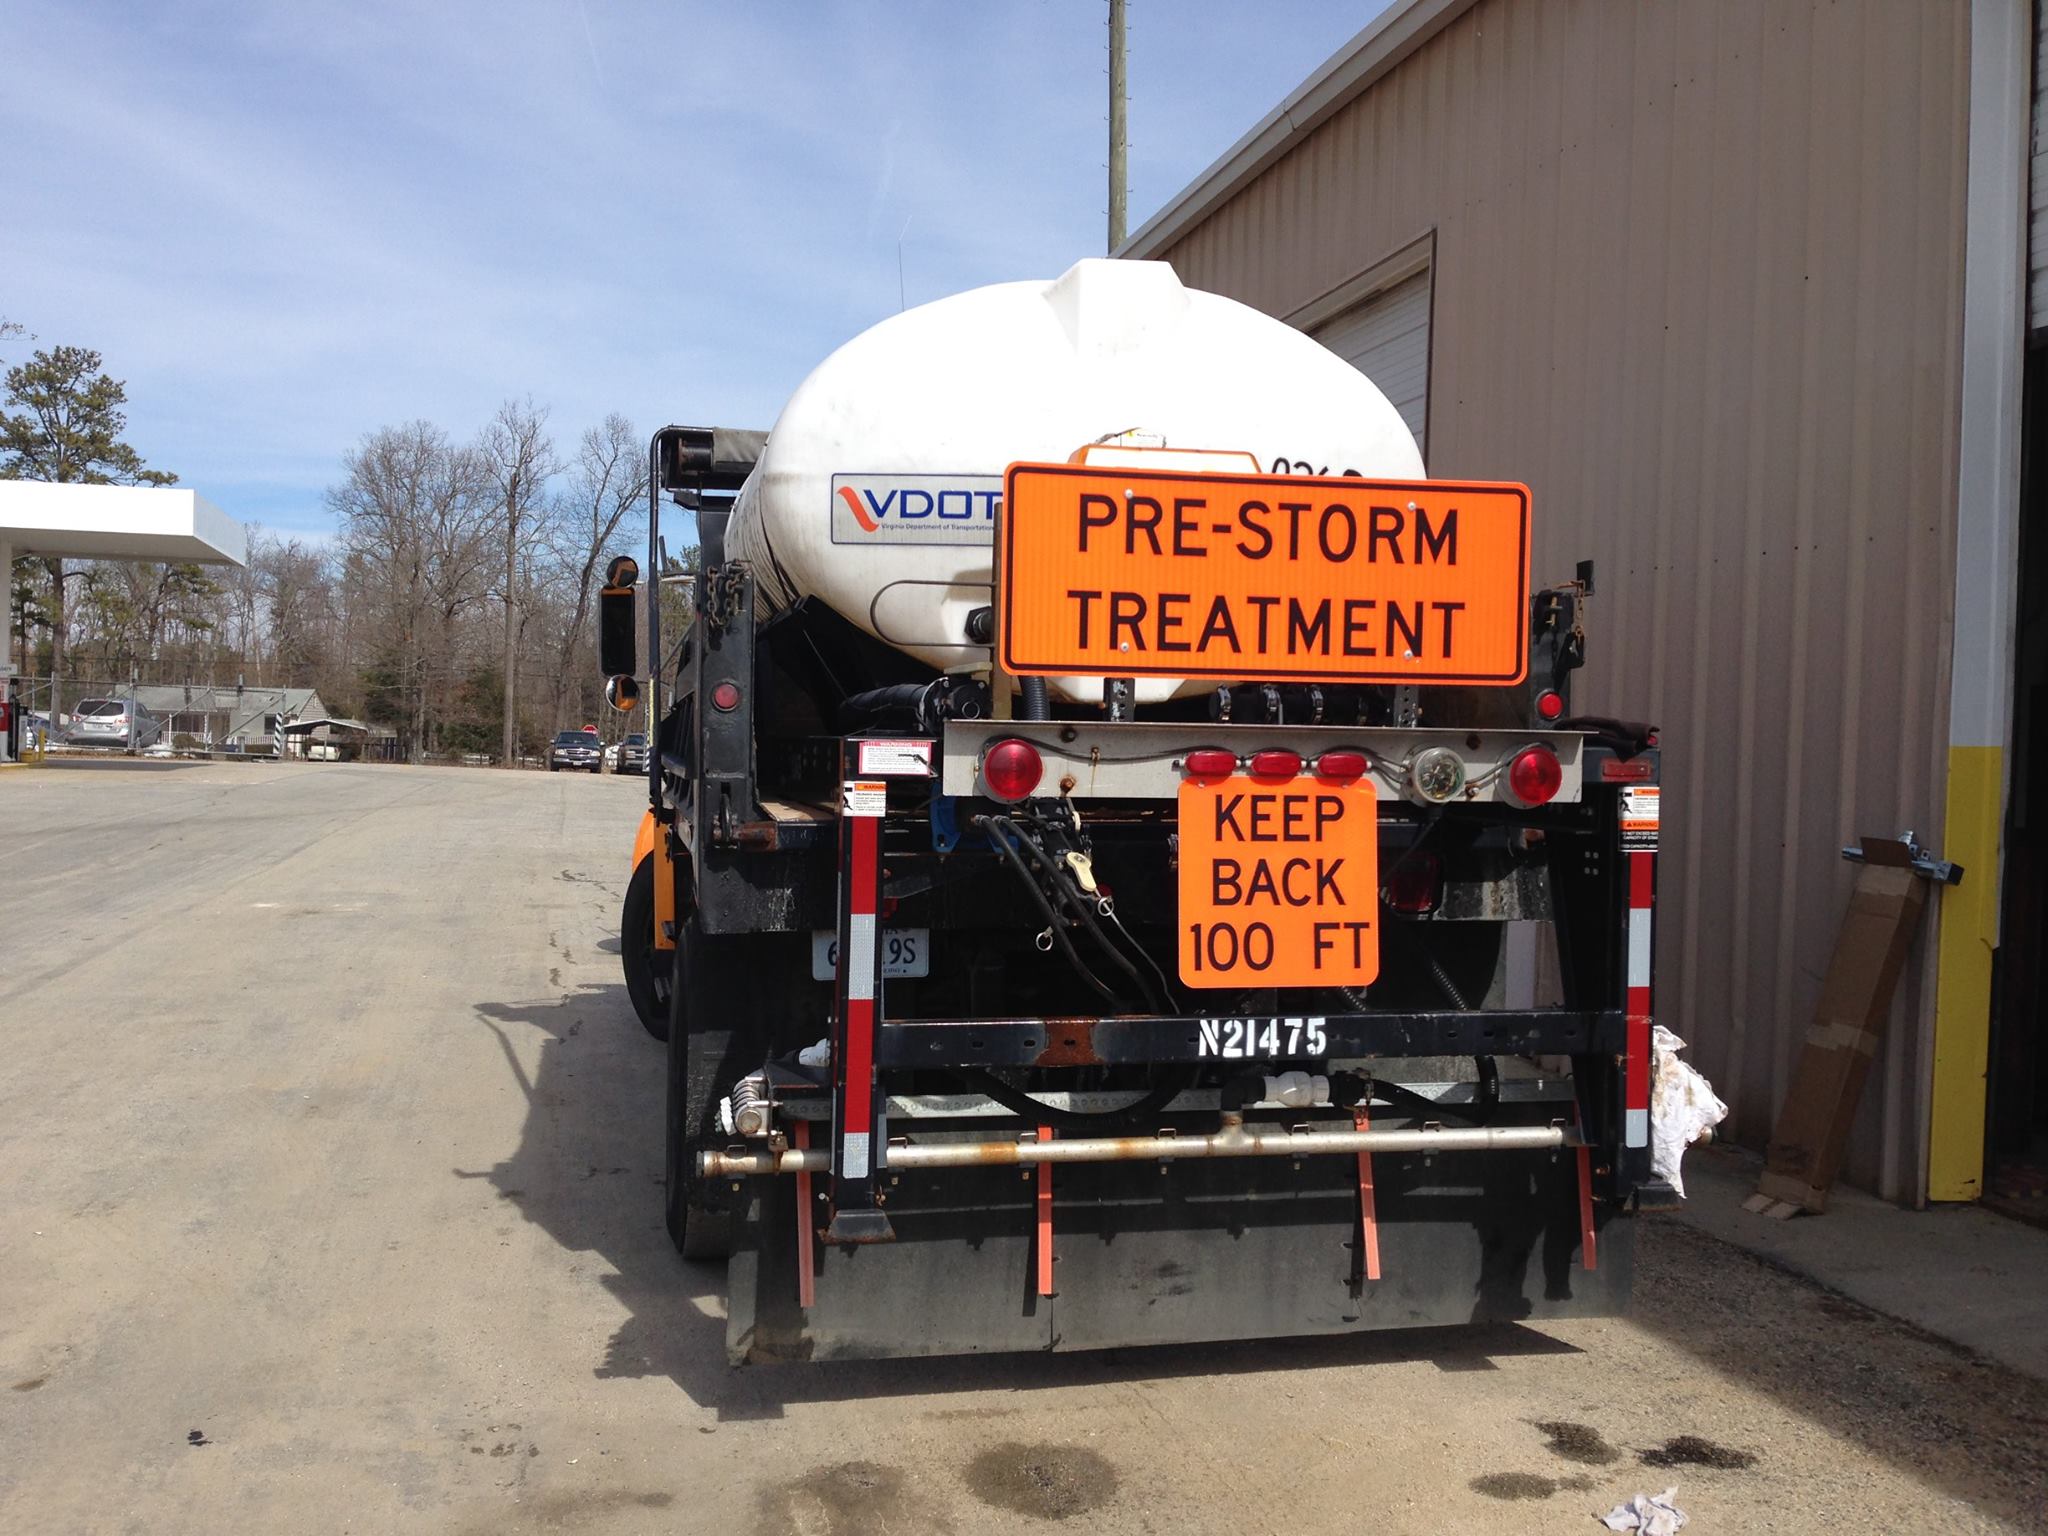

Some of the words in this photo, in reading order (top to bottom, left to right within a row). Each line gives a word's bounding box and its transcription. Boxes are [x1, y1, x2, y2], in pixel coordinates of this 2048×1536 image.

[863, 489, 1003, 520] VDOT
[881, 523, 904, 531] Virginia
[906, 523, 941, 531] Department
[1079, 493, 1458, 566] PRE-STORM
[1067, 589, 1466, 659] TREATMENT
[1215, 794, 1345, 842] KEEP
[1213, 858, 1345, 907] BACK
[1191, 921, 1275, 972] 100
[1313, 921, 1371, 970] FT
[1198, 1017, 1327, 1058] N21475
